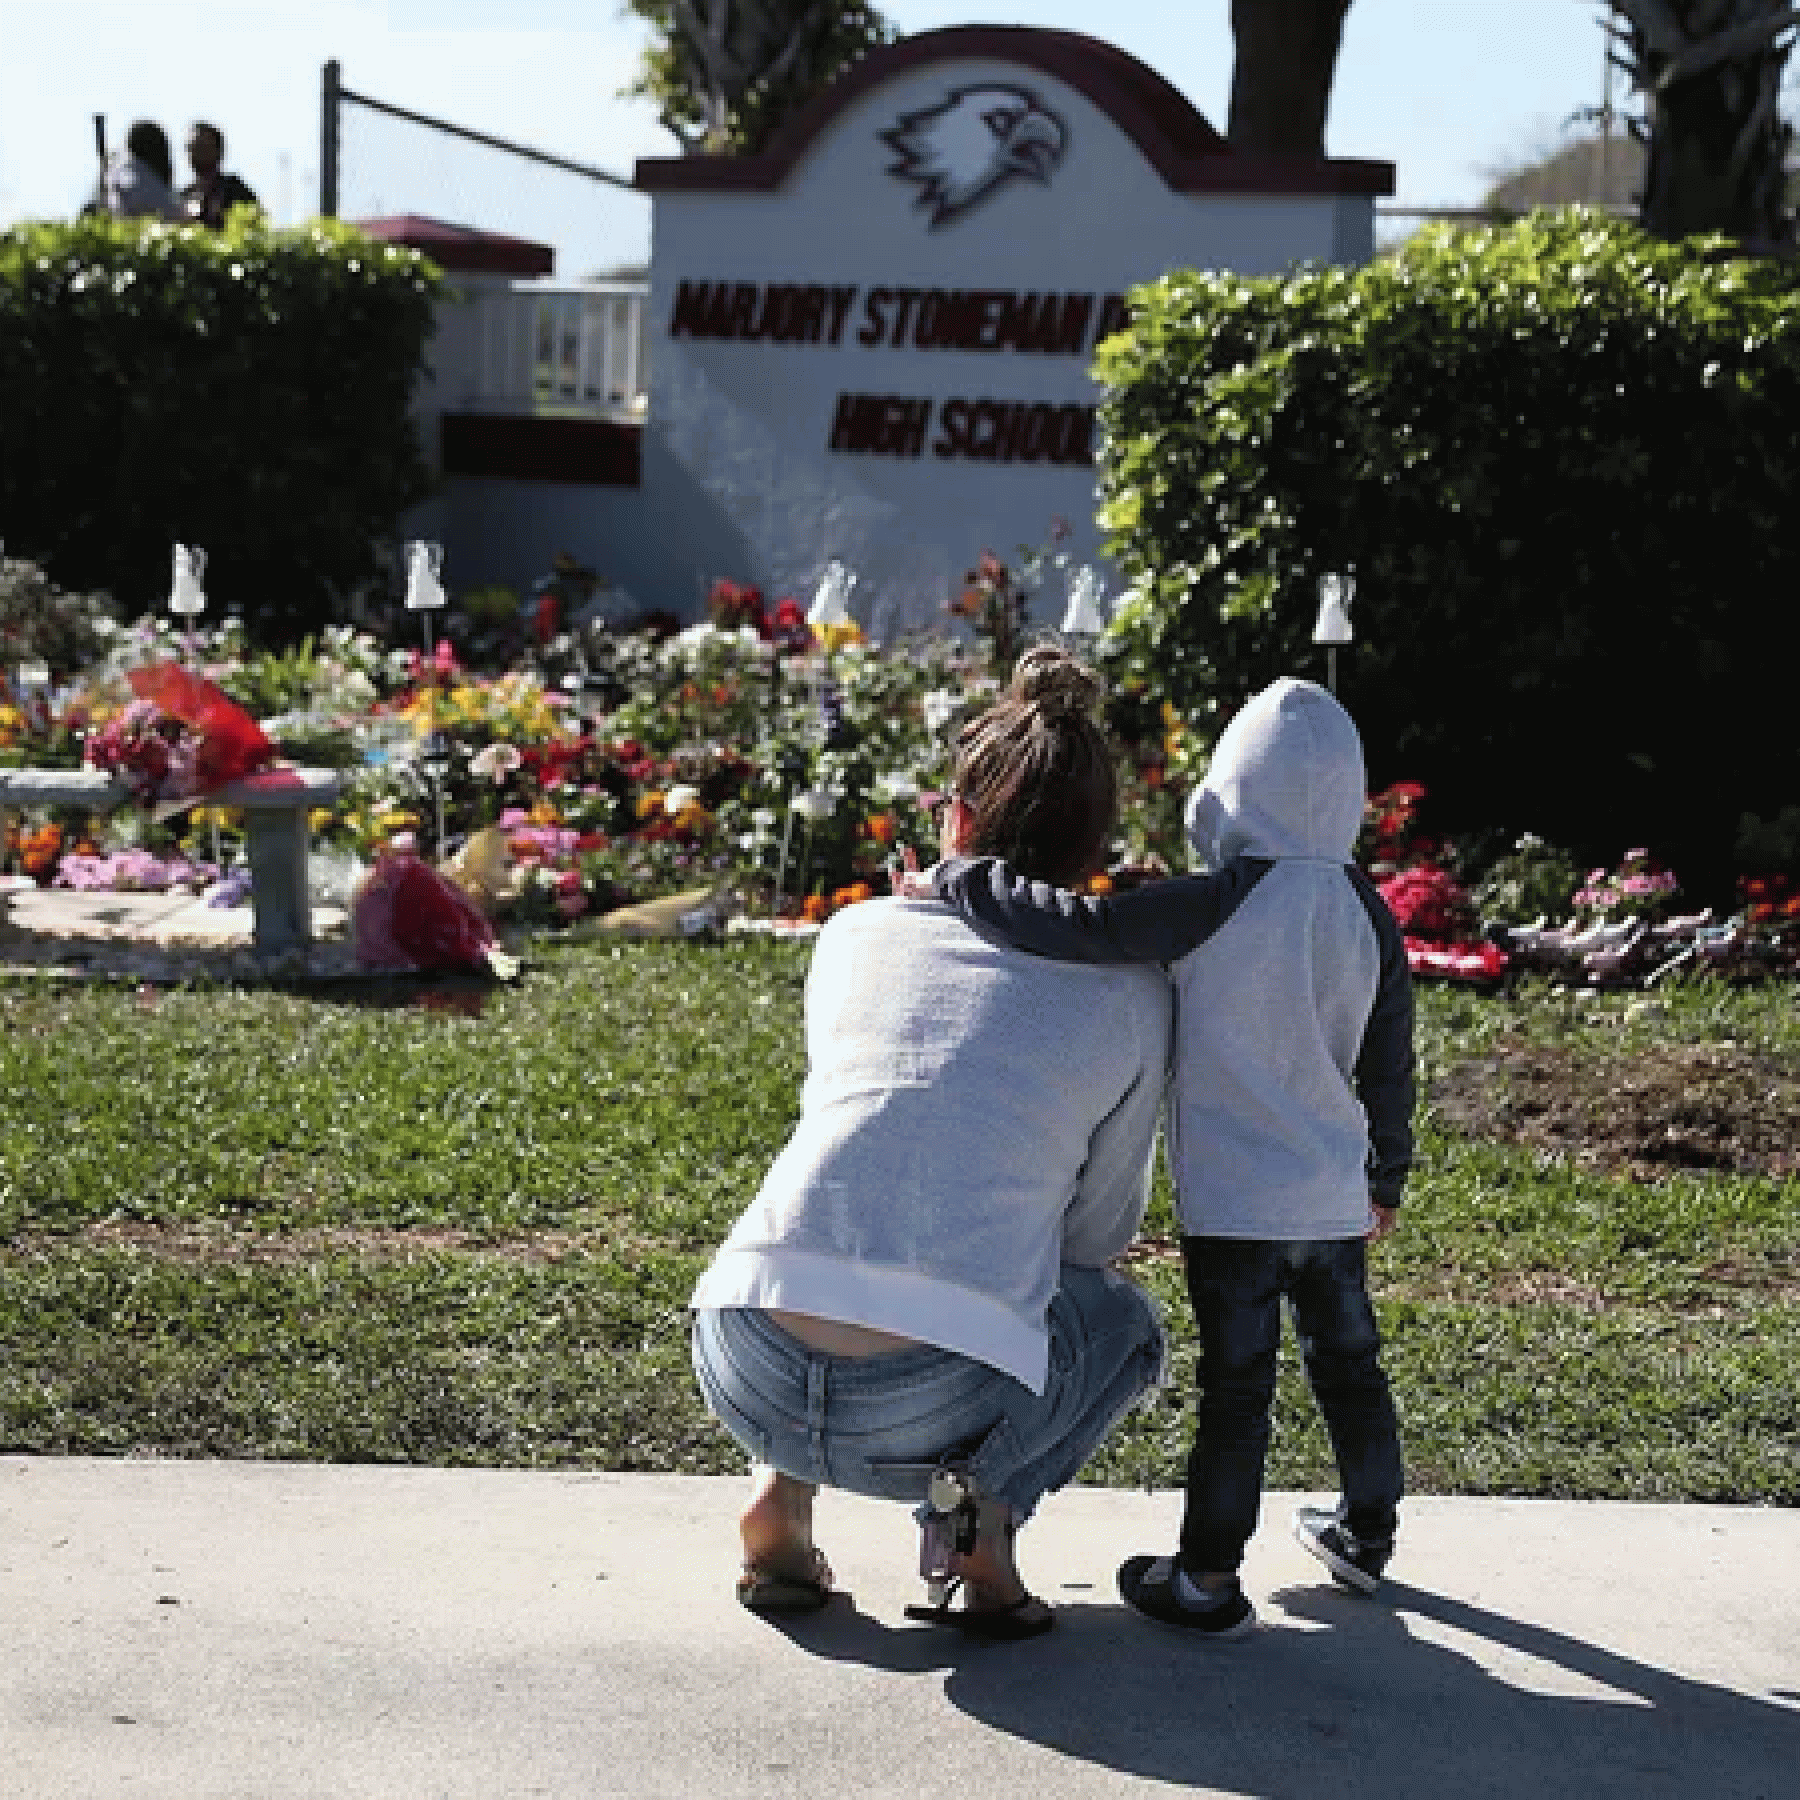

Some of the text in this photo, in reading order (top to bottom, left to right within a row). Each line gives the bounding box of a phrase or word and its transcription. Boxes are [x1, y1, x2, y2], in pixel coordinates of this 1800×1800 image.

[670, 279, 858, 347] MARJORY
[859, 286, 1096, 355] STONEMAN
[829, 393, 932, 458] HIGH
